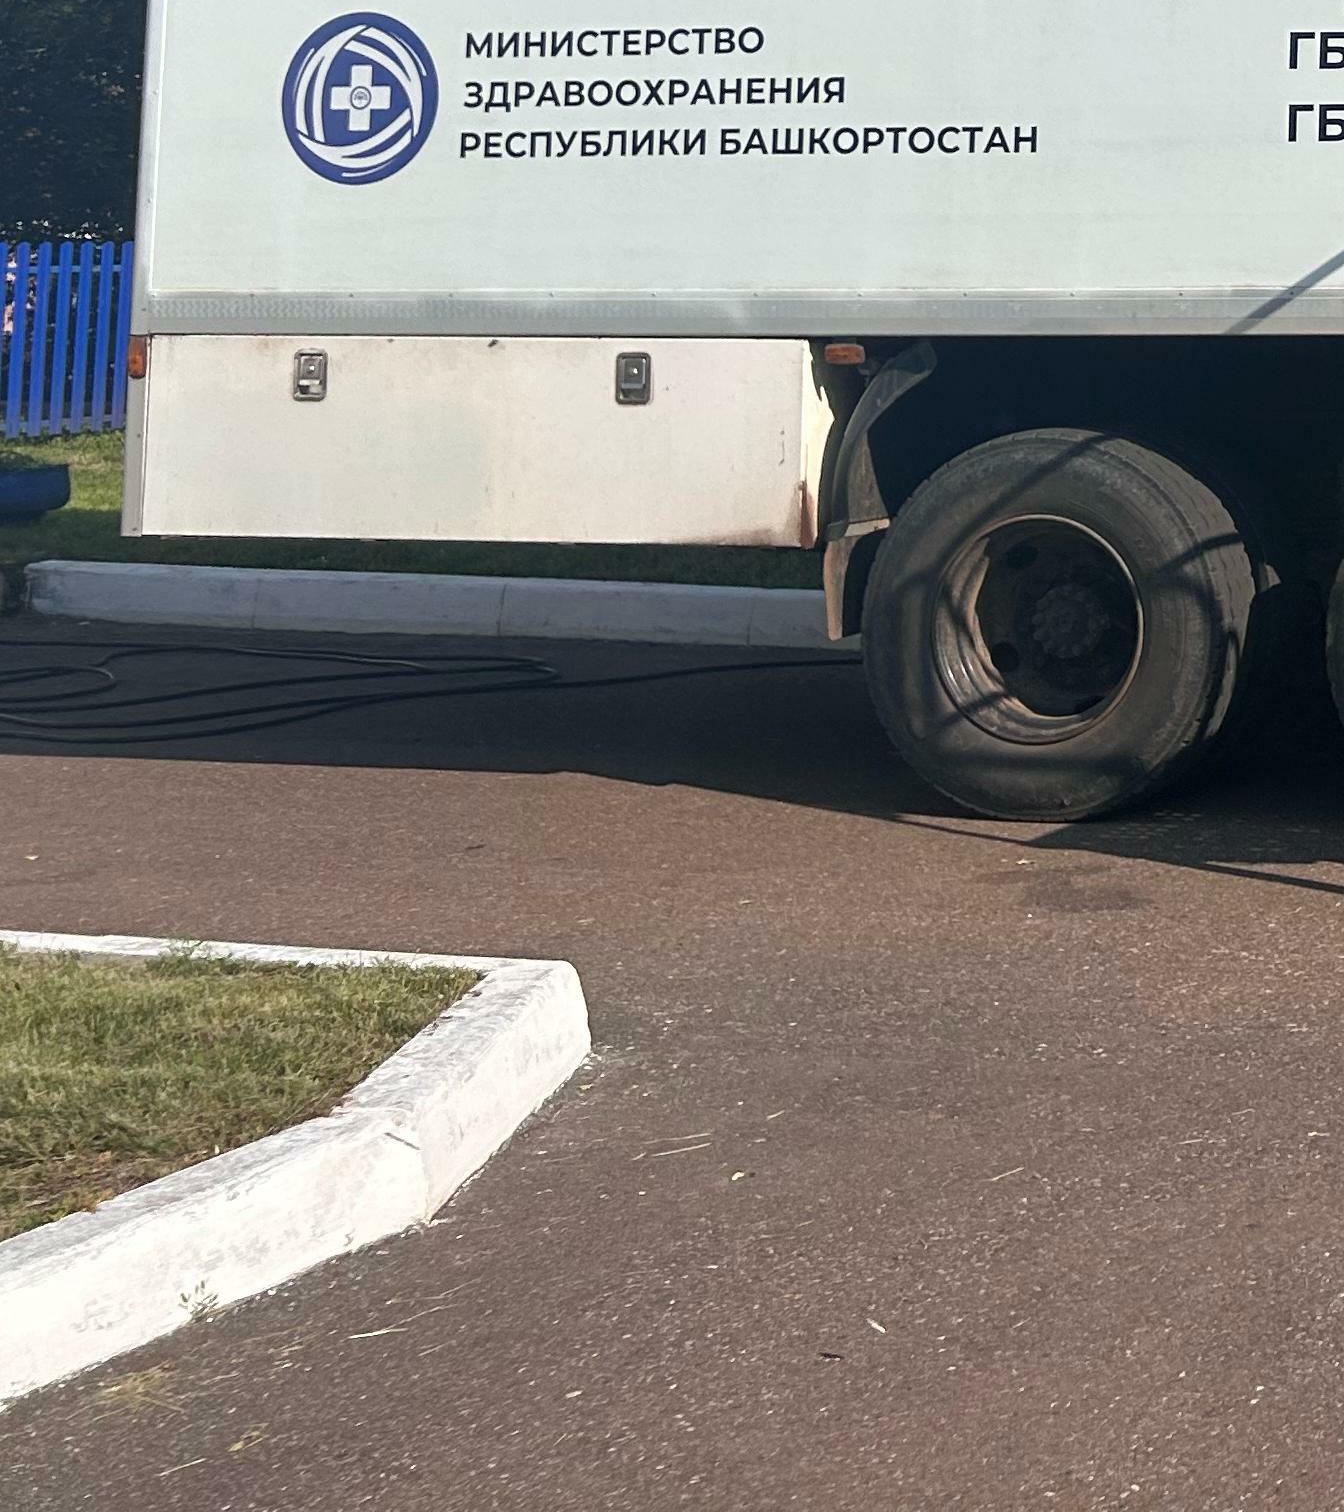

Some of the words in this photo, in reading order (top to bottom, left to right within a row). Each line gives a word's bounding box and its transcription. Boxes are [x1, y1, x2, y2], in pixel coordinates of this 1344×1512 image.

[466, 26, 765, 59] МИНИСТЕРСТВО
[463, 76, 845, 113] ЗДРАВООХРАНЕНИЯ
[459, 128, 707, 159] РЕСПУБЛИКИ
[719, 126, 1038, 155] БАШКОРТОСТАН
